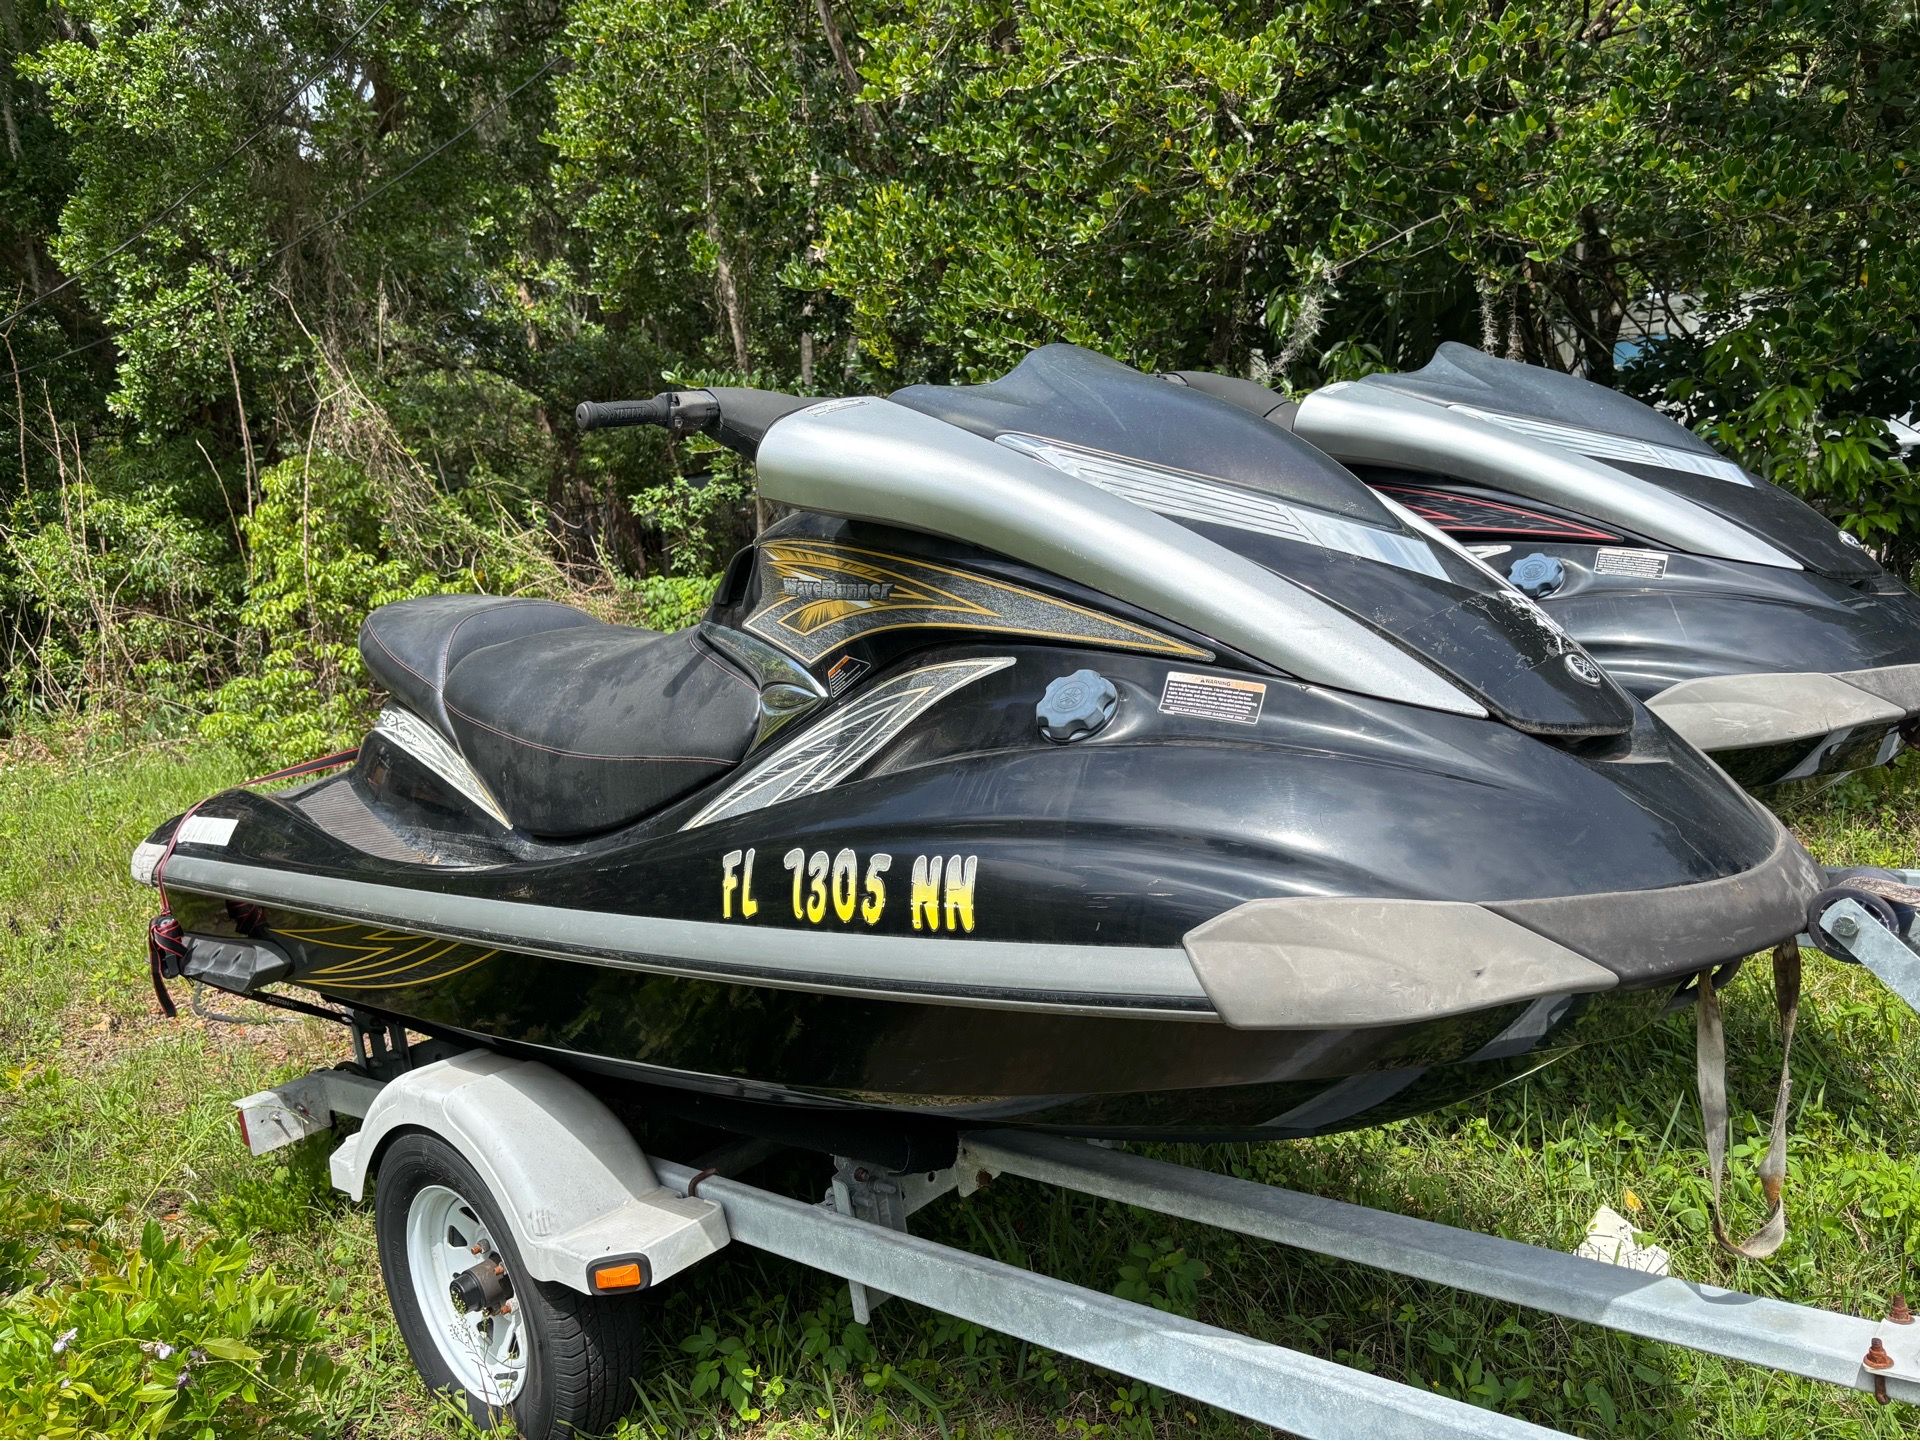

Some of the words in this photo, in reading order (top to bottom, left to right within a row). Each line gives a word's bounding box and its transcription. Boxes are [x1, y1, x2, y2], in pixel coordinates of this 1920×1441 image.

[782, 577, 894, 600] WaveRunner
[1205, 679, 1231, 687] WARNING
[723, 848, 758, 919] FL
